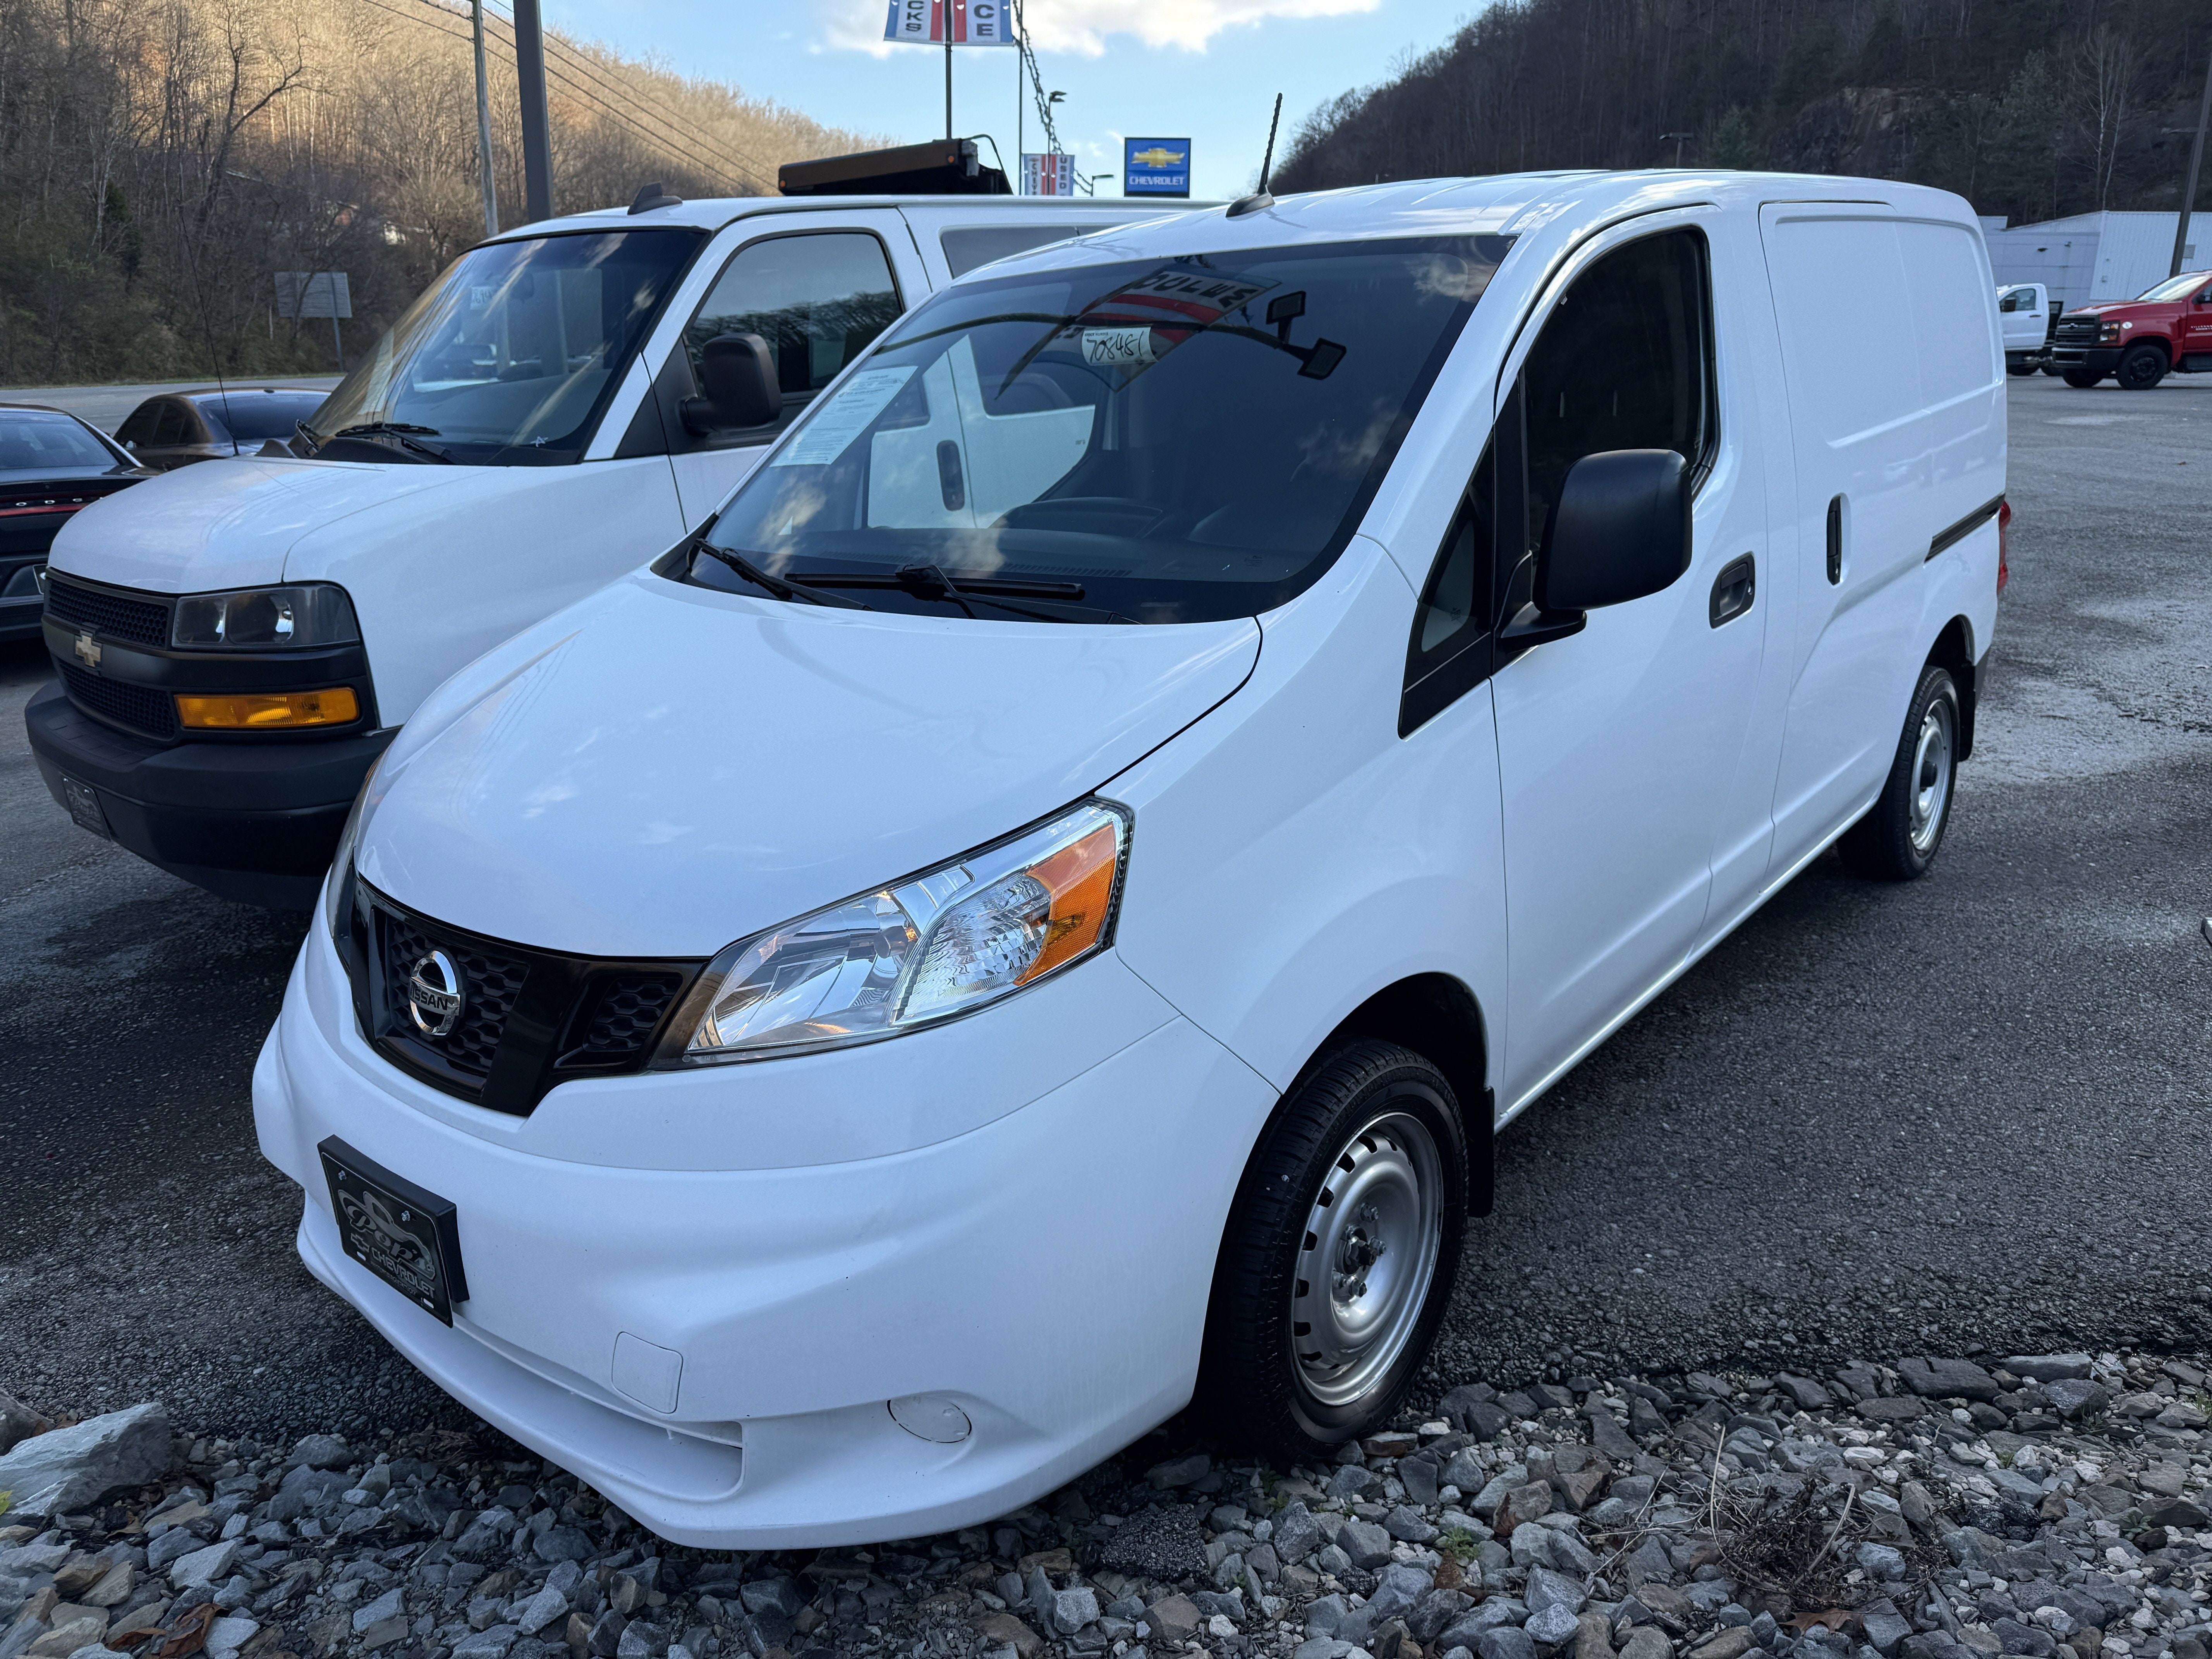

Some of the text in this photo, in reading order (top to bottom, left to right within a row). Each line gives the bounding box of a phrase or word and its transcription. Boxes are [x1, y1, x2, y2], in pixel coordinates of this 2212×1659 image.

[974, 0, 994, 36] CE
[1129, 176, 1184, 185] CHEVROLET
[371, 1247, 435, 1298] CHEVROLET
